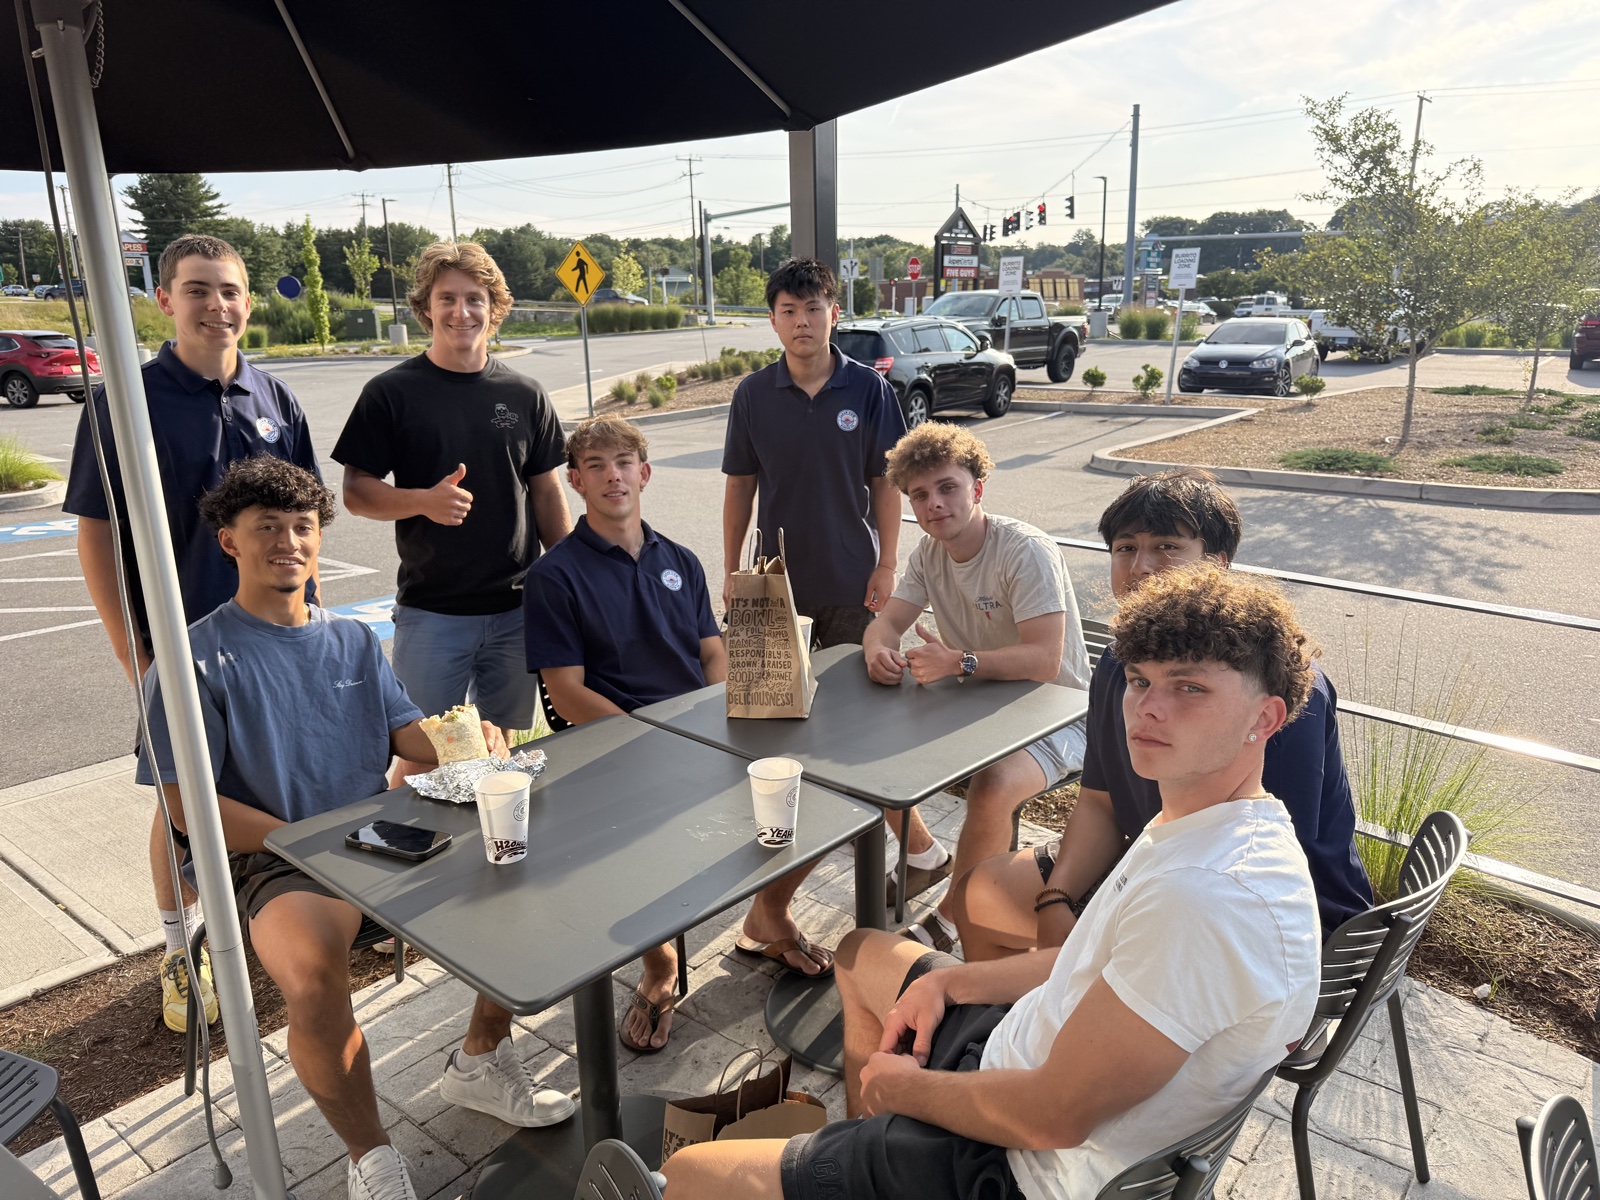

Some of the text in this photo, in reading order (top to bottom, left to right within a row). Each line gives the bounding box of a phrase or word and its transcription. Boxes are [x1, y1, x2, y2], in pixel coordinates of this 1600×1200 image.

[908, 264, 922, 273] STOP
[946, 268, 975, 277] FIVE GUYS
[731, 597, 749, 608] IT'S
[751, 597, 770, 608] NOT
[780, 597, 786, 608] A
[730, 609, 775, 627] BOWL
[745, 627, 763, 636] FOIL
[729, 649, 781, 659] RESPONSIBLY
[731, 660, 757, 669] GROWN
[728, 671, 754, 683] GOOD
[727, 691, 794, 707] DELICIOUSNESS!
[665, 1128, 685, 1147] IT'S
